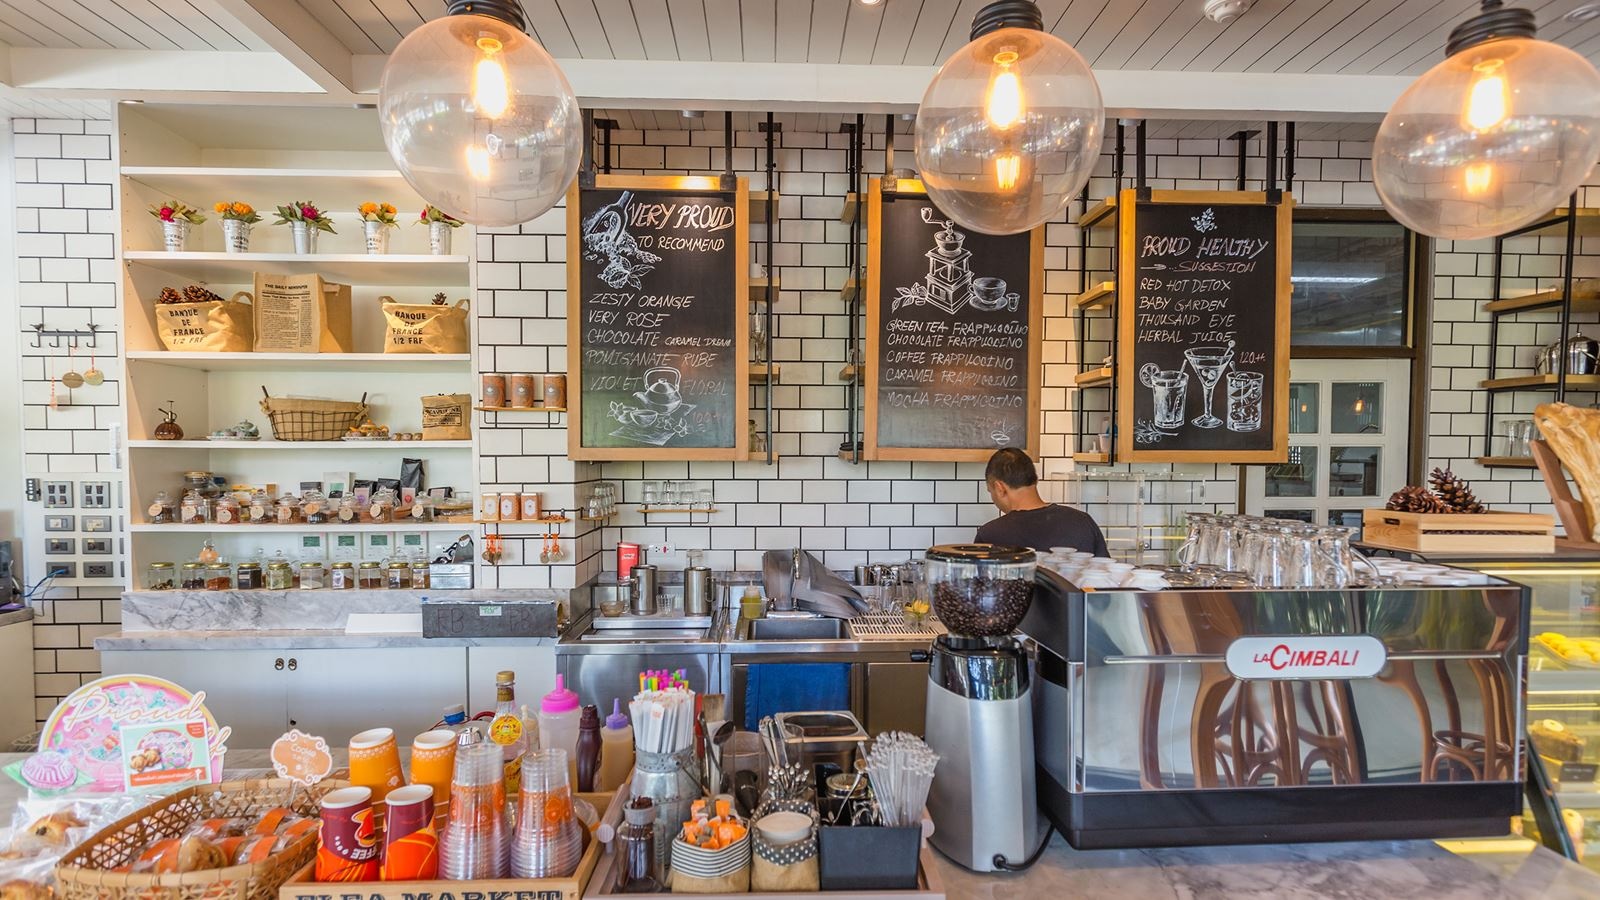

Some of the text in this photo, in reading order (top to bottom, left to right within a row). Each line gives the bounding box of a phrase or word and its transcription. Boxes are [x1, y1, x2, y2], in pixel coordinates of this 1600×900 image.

[629, 203, 734, 232] VERY PROUD
[638, 236, 725, 251] TO RECOMMEND
[1141, 235, 1269, 259] PROUD HEALTHY
[1140, 278, 1231, 293] RED HOT DETOX
[589, 293, 694, 309] ZESTY ORANGE
[1139, 296, 1228, 312] BABY GARDEN
[395, 311, 427, 320] BANQUE
[589, 311, 670, 328] VERY ROSE
[1138, 313, 1236, 327] THOUSAND EYE
[173, 328, 205, 337] FRANCE
[886, 319, 924, 333] GREEN
[924, 321, 948, 333] TEA
[587, 328, 660, 346] CHOCOLATE
[664, 337, 701, 347] CARAMEL
[887, 334, 944, 347] CHOCOLATE
[1138, 329, 1237, 344] HERBAL JUICE
[886, 350, 925, 363] COFFEE
[886, 368, 935, 382] CARAMEL
[887, 391, 929, 408] MOCHA
[1270, 644, 1359, 671] CIMBALI
[64, 685, 207, 731] Proud
